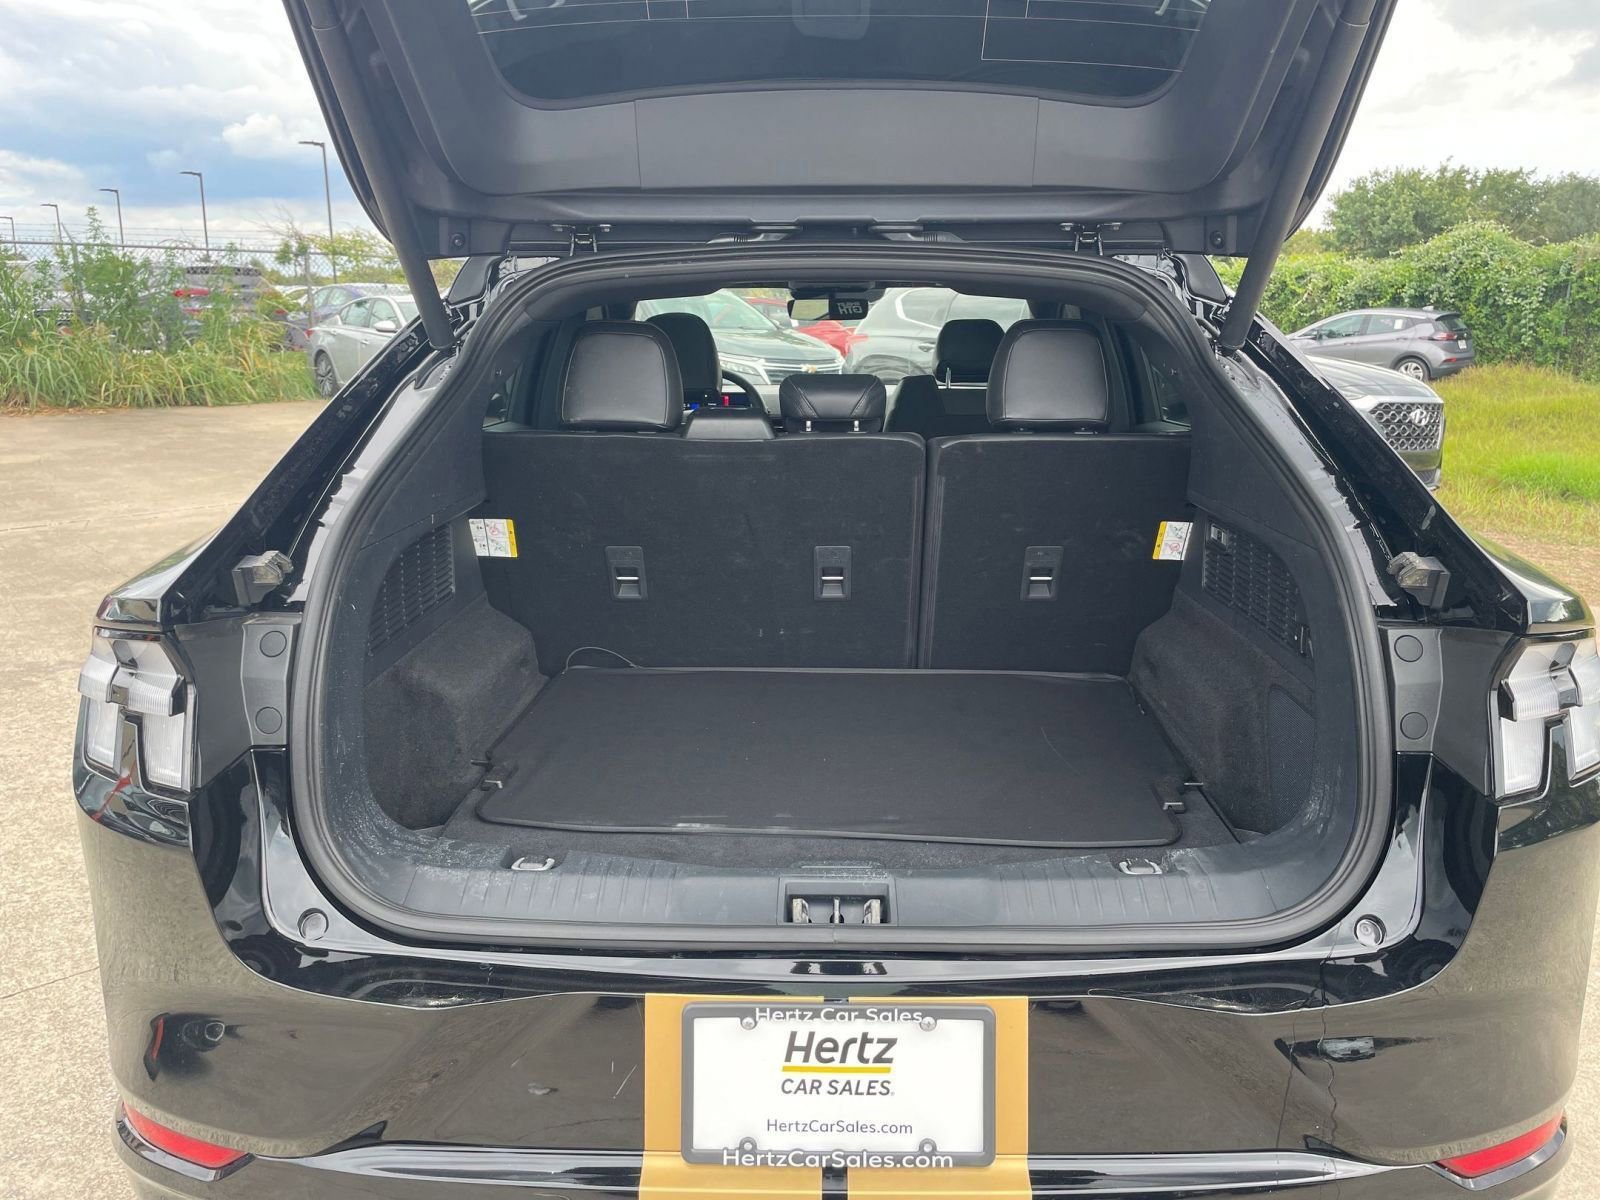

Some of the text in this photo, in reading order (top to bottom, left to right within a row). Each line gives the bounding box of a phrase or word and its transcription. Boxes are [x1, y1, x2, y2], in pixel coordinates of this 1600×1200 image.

[755, 1007, 923, 1024] Hertz Car Sales
[784, 1031, 898, 1064] Hertz
[781, 1078, 891, 1096] CAR SALES
[766, 1119, 913, 1135] HertzCarSales.com
[722, 1149, 953, 1169] HertzCarSales.com
